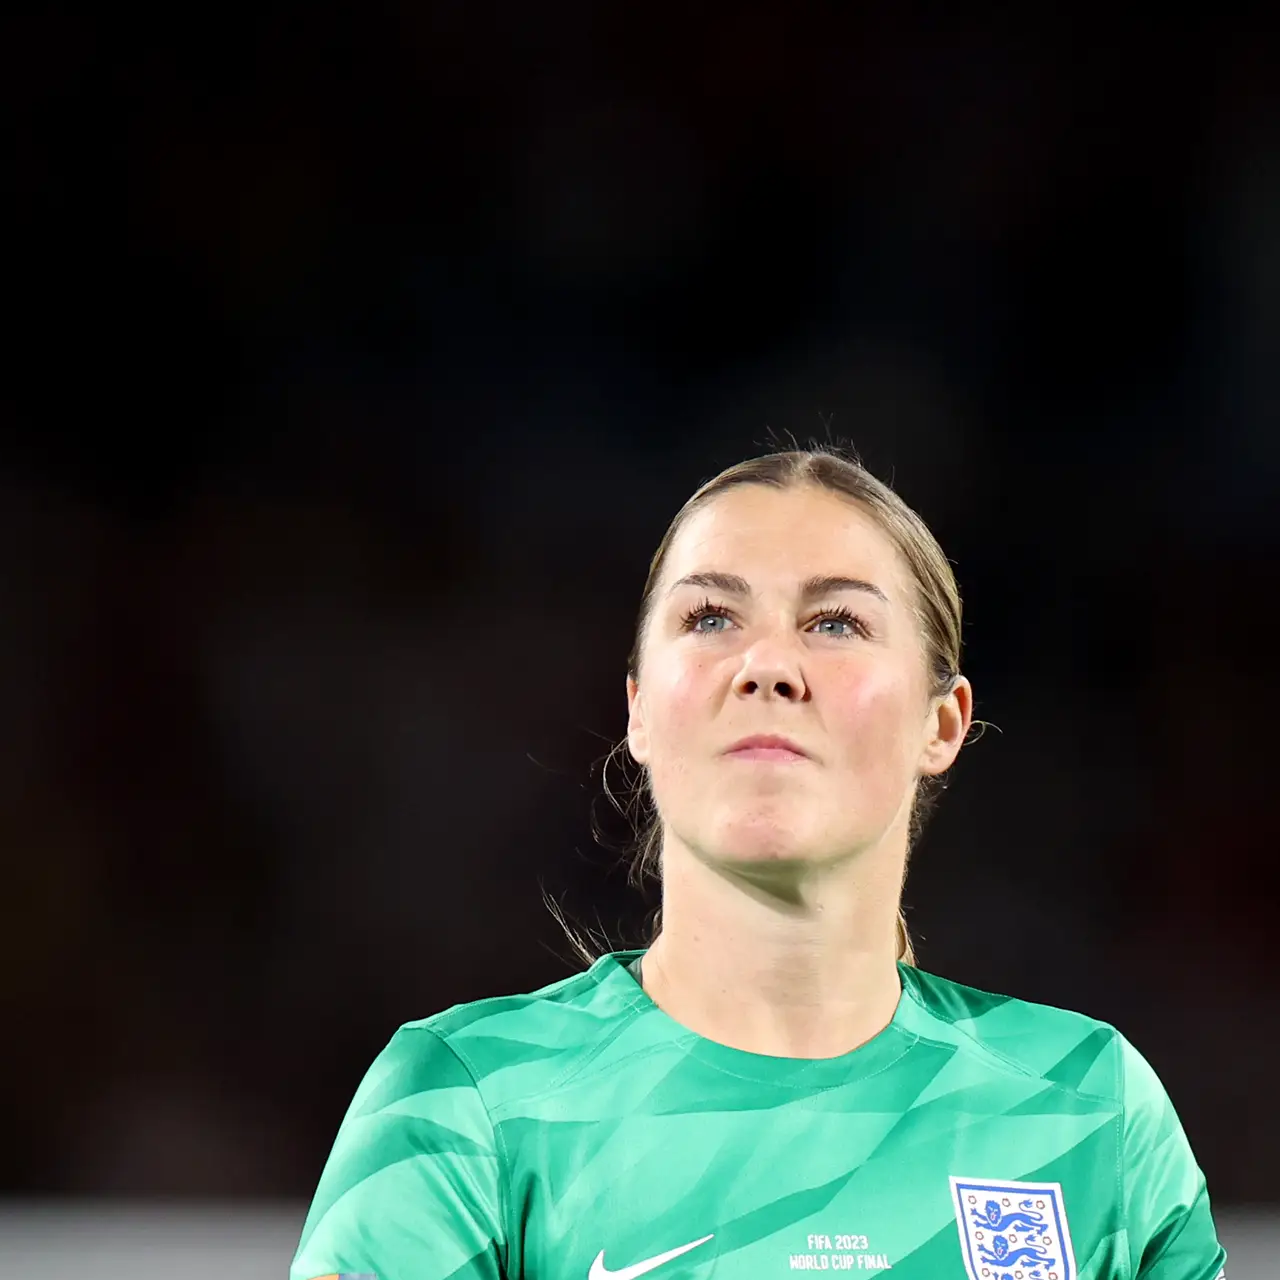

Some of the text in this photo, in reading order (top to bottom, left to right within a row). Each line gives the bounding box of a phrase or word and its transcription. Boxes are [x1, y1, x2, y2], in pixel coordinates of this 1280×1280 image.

[807, 1234, 869, 1250] FIFA 2023
[789, 1253, 892, 1271] WORLD CUP FINAL
